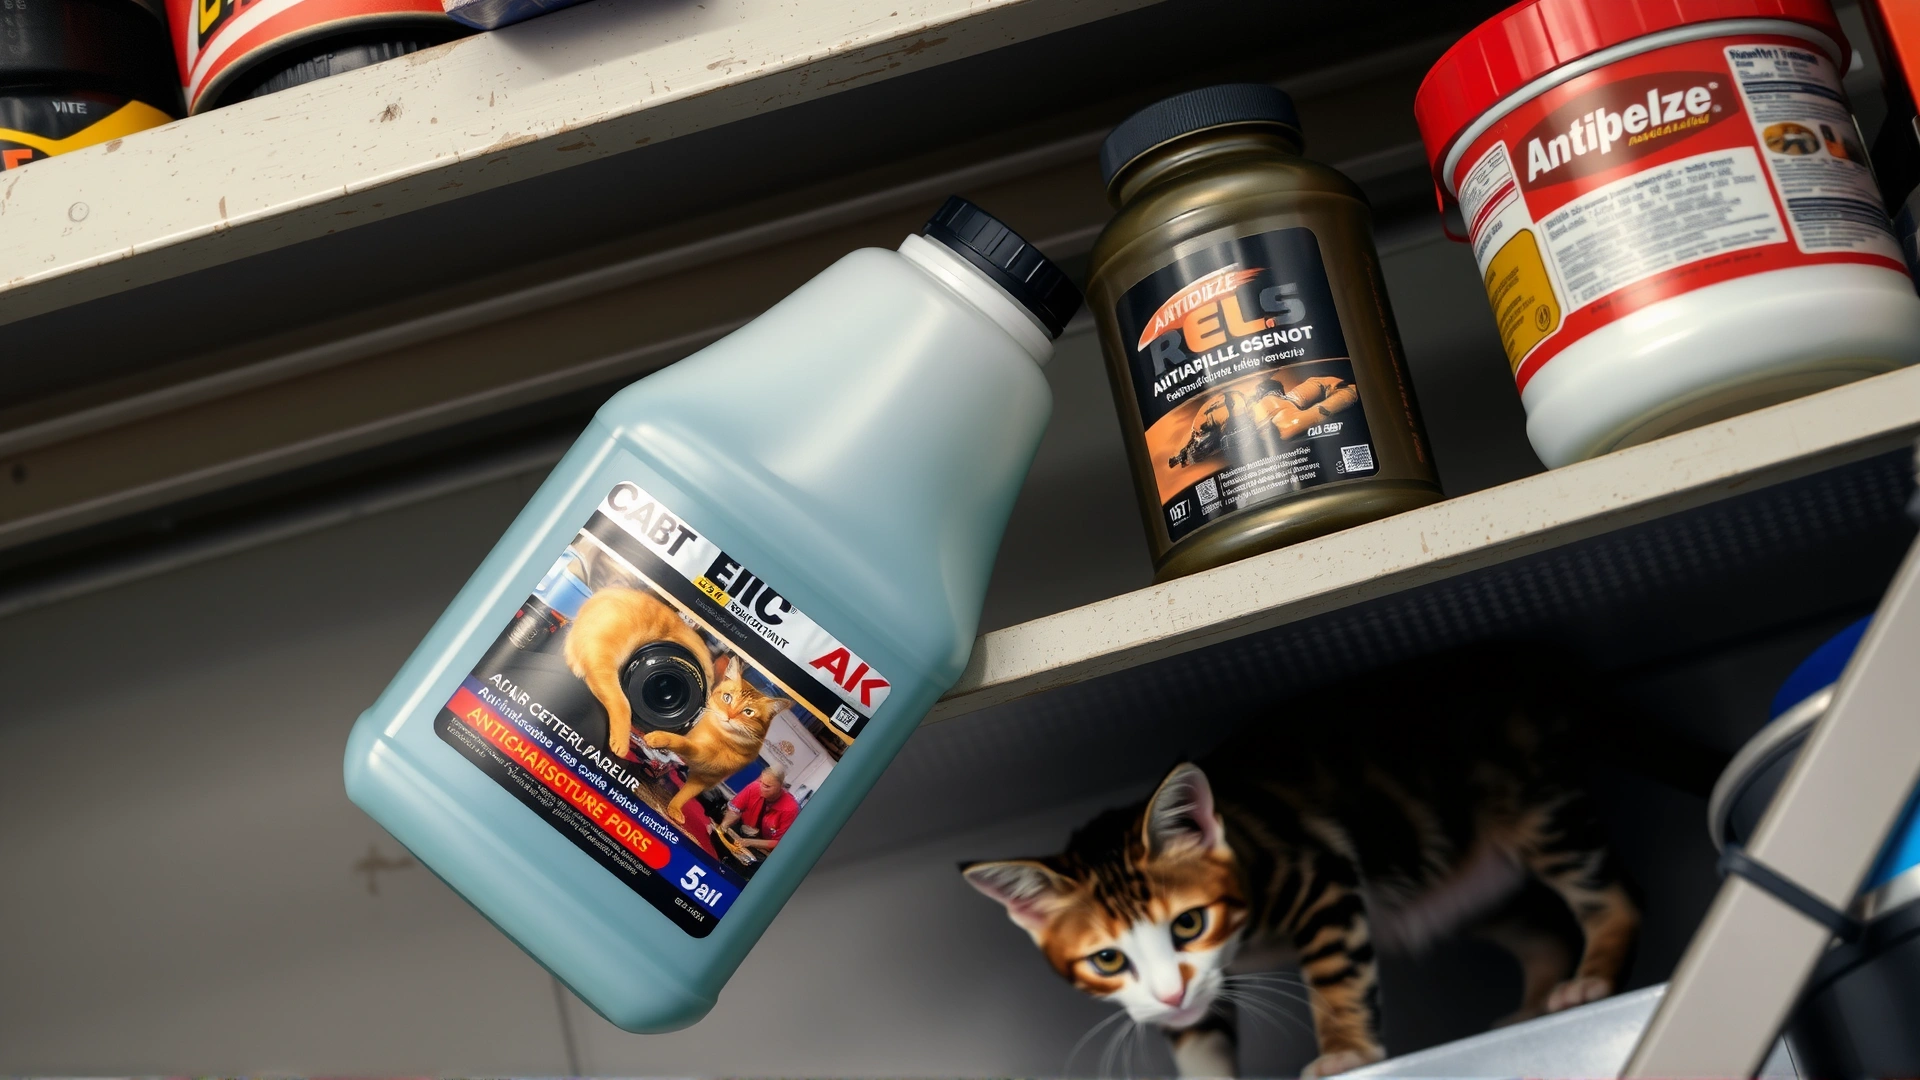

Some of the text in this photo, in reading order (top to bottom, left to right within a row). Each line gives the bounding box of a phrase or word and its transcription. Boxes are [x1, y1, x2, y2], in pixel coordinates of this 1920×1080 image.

[1527, 87, 1712, 182] Antipelze
[608, 483, 697, 556] CABT
[809, 645, 890, 708] AK
